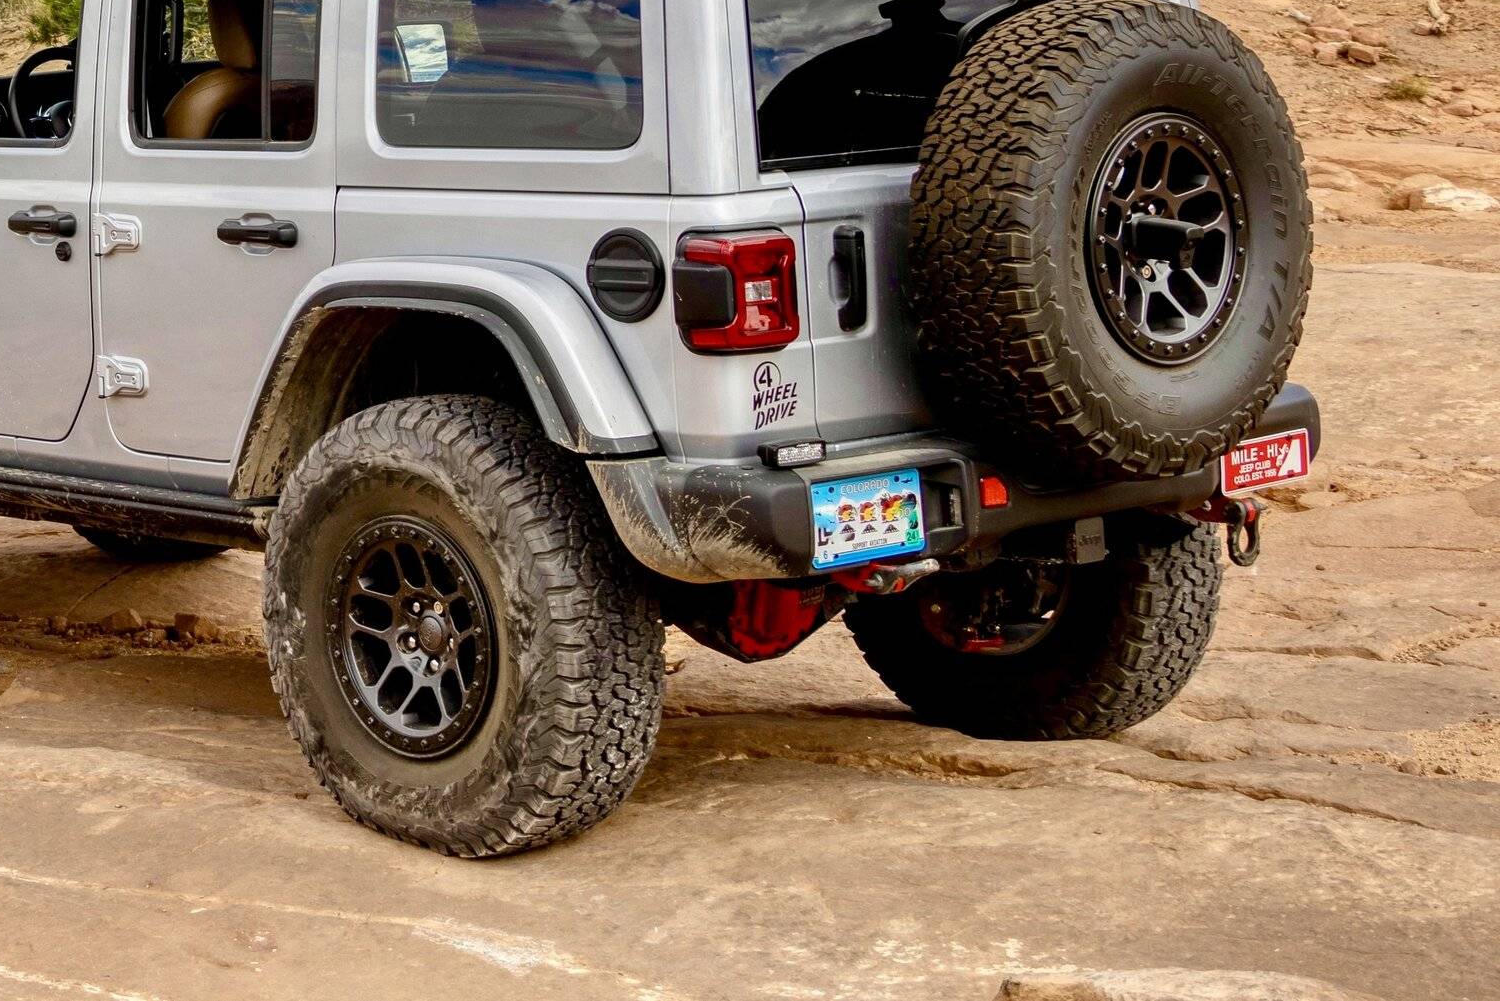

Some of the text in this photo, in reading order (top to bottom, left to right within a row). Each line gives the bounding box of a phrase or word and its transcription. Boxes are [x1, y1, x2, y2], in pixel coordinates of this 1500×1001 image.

[758, 365, 772, 388] 4
[753, 382, 797, 411] WHEEL
[754, 400, 797, 430] DRIVE
[1231, 447, 1258, 466] MILE
[1239, 460, 1271, 473] JEEP CLUB
[840, 479, 889, 495] COLORADO
